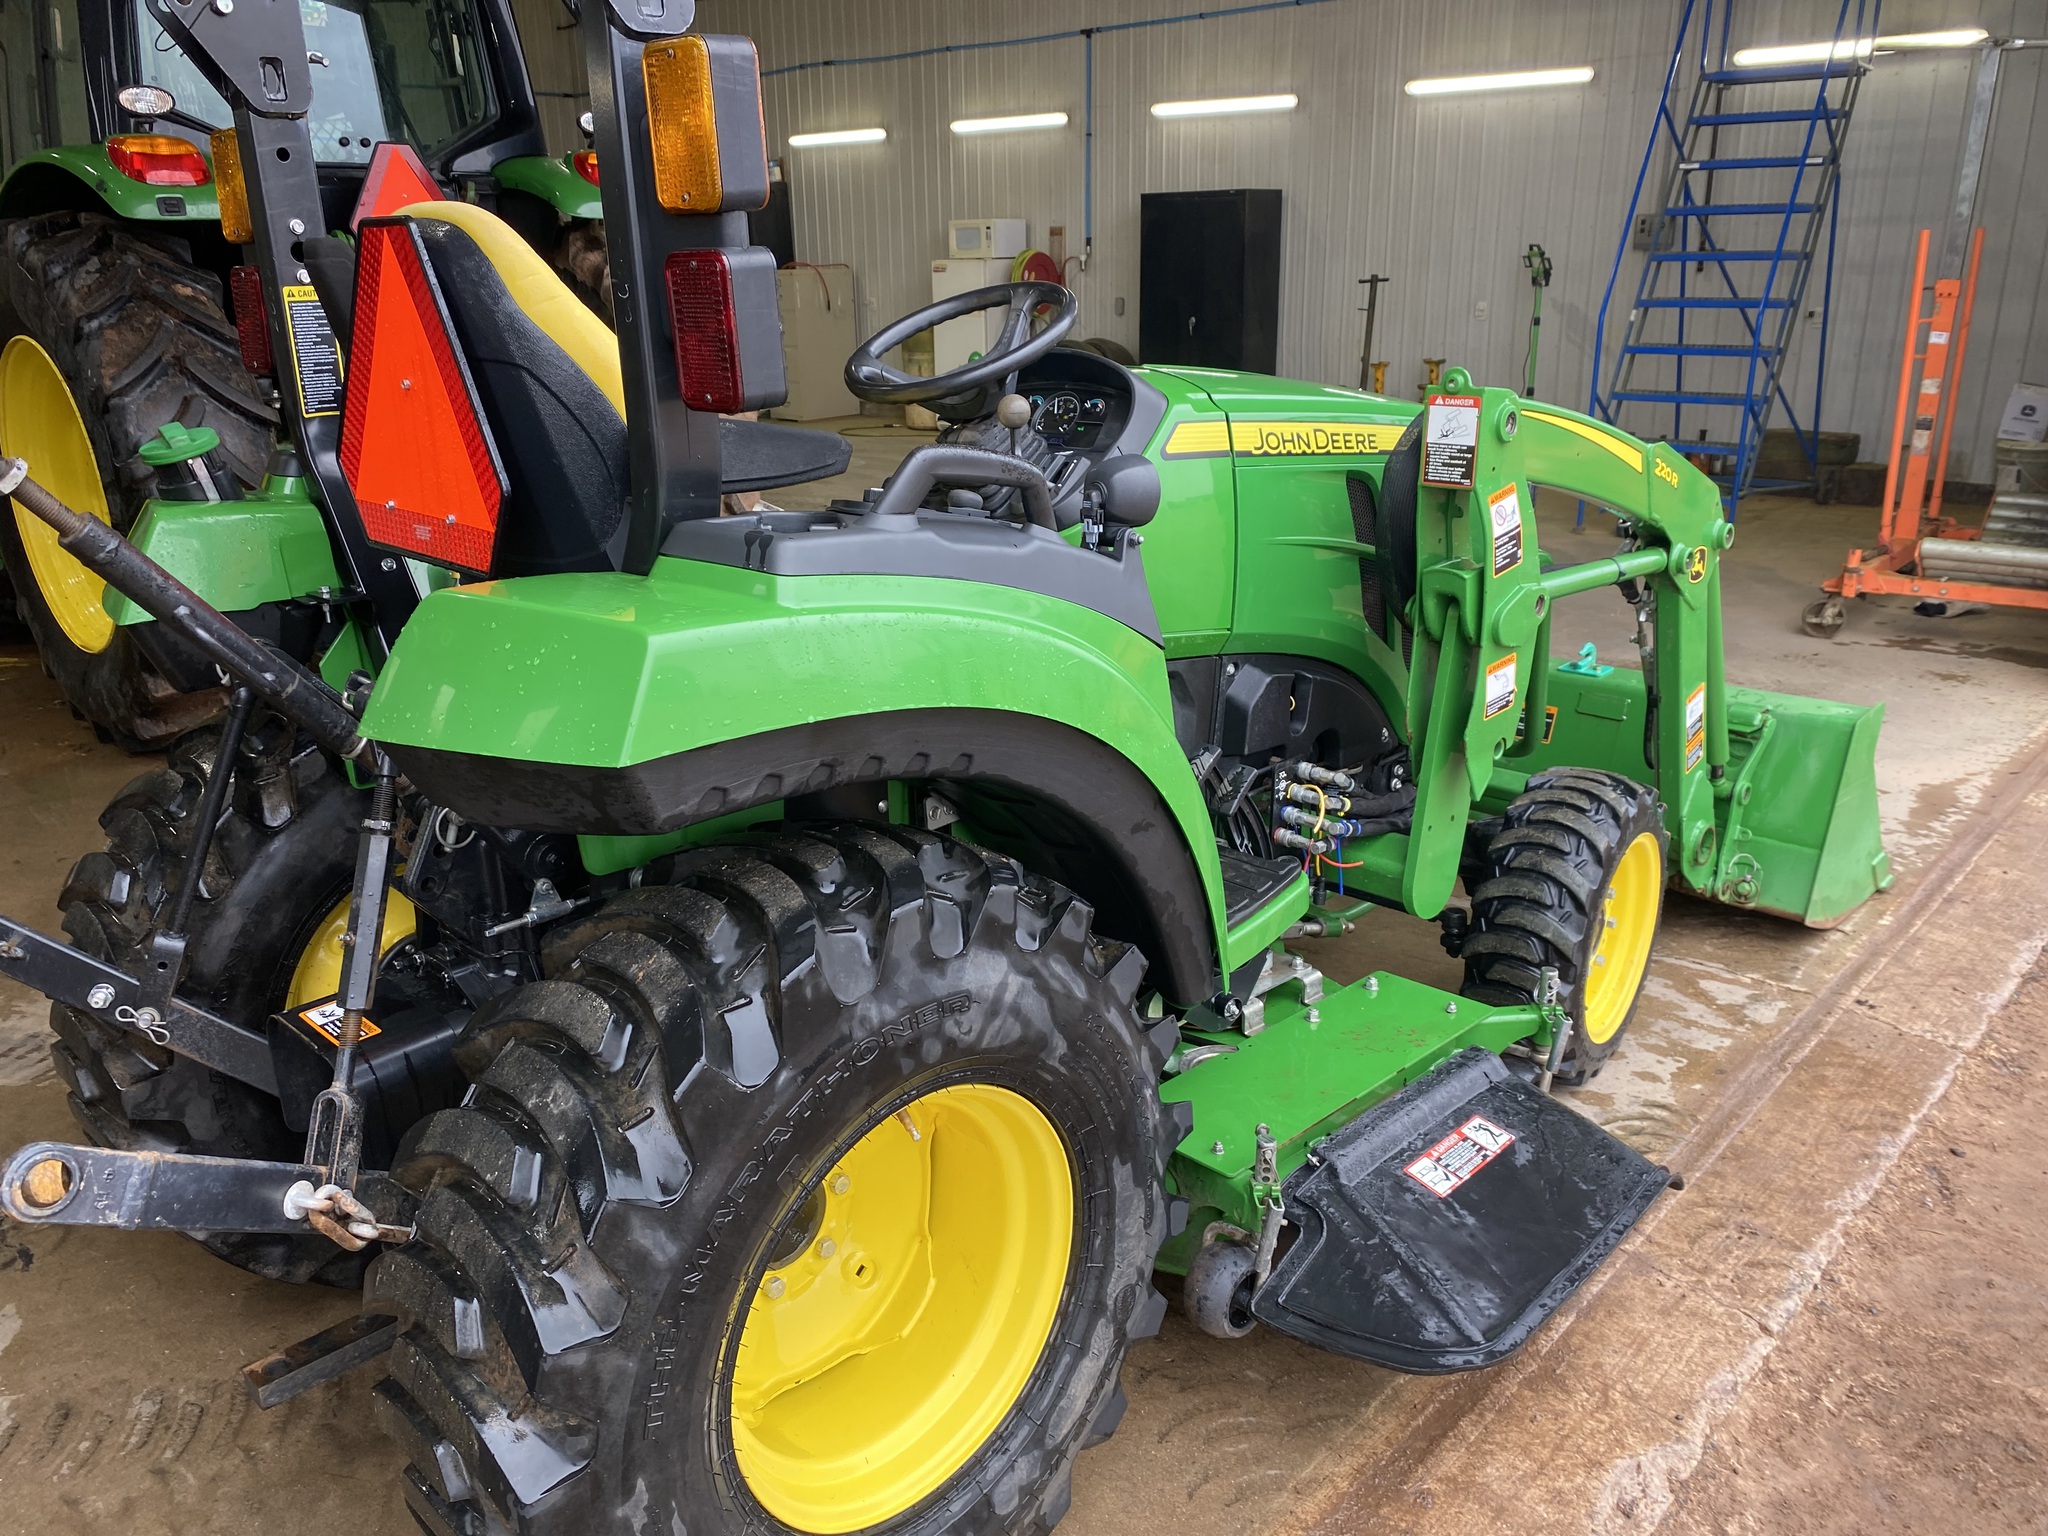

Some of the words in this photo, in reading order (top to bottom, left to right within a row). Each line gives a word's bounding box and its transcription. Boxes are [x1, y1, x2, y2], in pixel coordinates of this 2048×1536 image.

[1445, 397, 1475, 407] DANGER
[1253, 427, 1310, 452] JOHN
[1314, 427, 1380, 452] DEERE
[1654, 457, 1679, 489] 220R
[1493, 483, 1516, 502] WARNING
[1491, 653, 1516, 672] WARNING
[1435, 1132, 1461, 1153] DANGER
